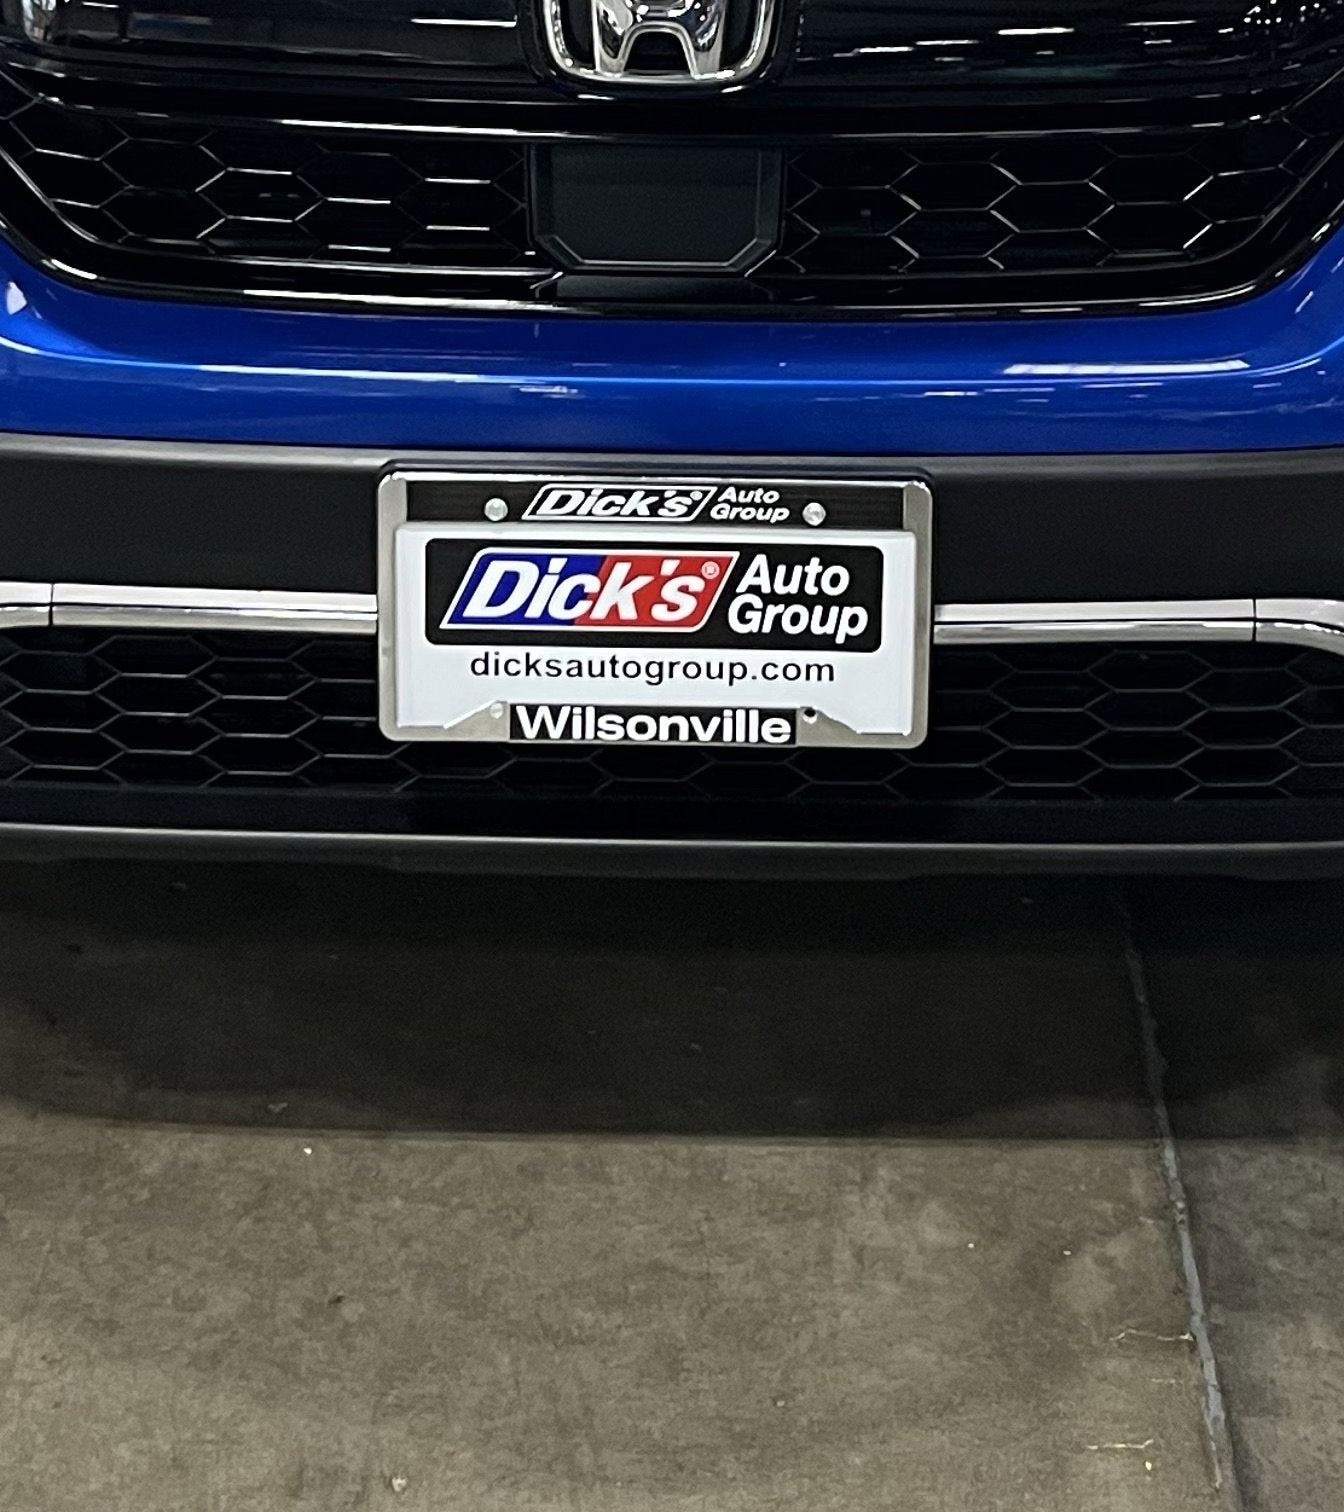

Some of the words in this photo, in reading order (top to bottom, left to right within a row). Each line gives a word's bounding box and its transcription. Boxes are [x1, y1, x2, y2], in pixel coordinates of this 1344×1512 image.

[709, 503, 791, 524] Group
[717, 487, 781, 505] Auto
[736, 553, 850, 597] Auto
[728, 595, 869, 645] Group
[470, 651, 836, 687] dicksautogroup.com
[516, 704, 793, 744] Wilsonville
